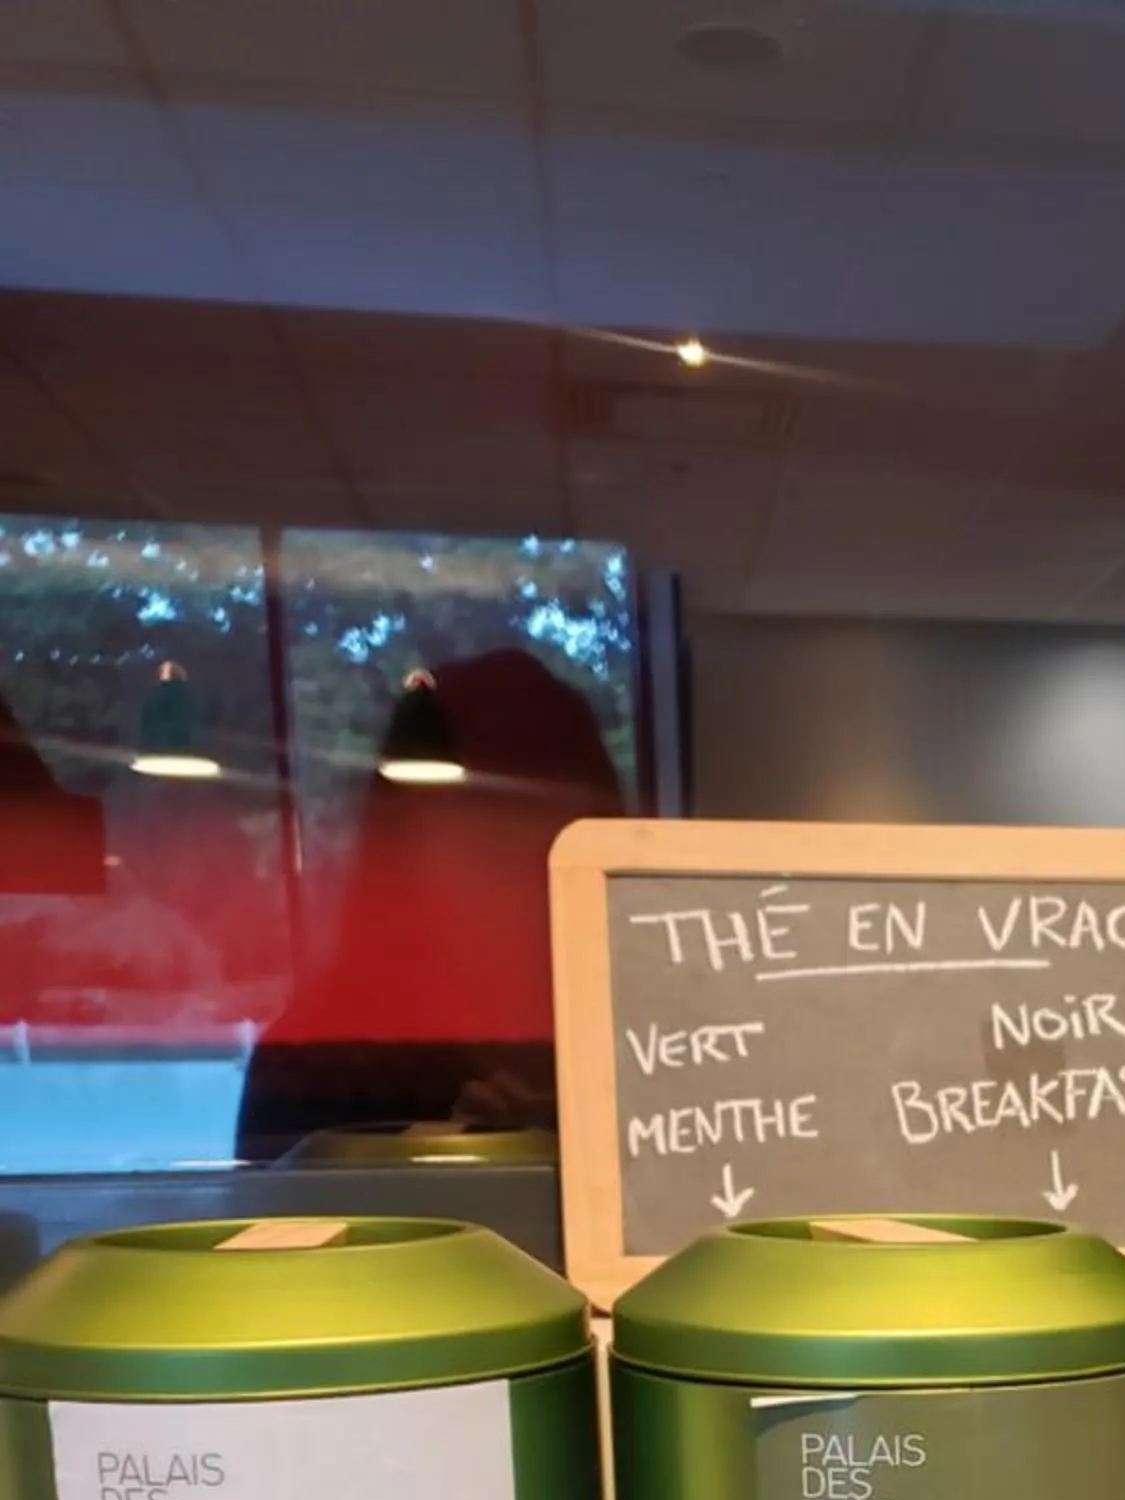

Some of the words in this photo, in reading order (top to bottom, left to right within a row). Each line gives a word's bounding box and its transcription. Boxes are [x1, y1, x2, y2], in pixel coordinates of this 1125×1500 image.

[630, 885, 811, 971] THÉ
[848, 900, 927, 955] EN
[626, 1021, 765, 1075] VERT
[627, 1094, 819, 1157] MENTHE
[97, 1451, 226, 1487] PALAIS
[800, 1432, 927, 1467] PALAIS
[802, 1466, 873, 1500] DES
